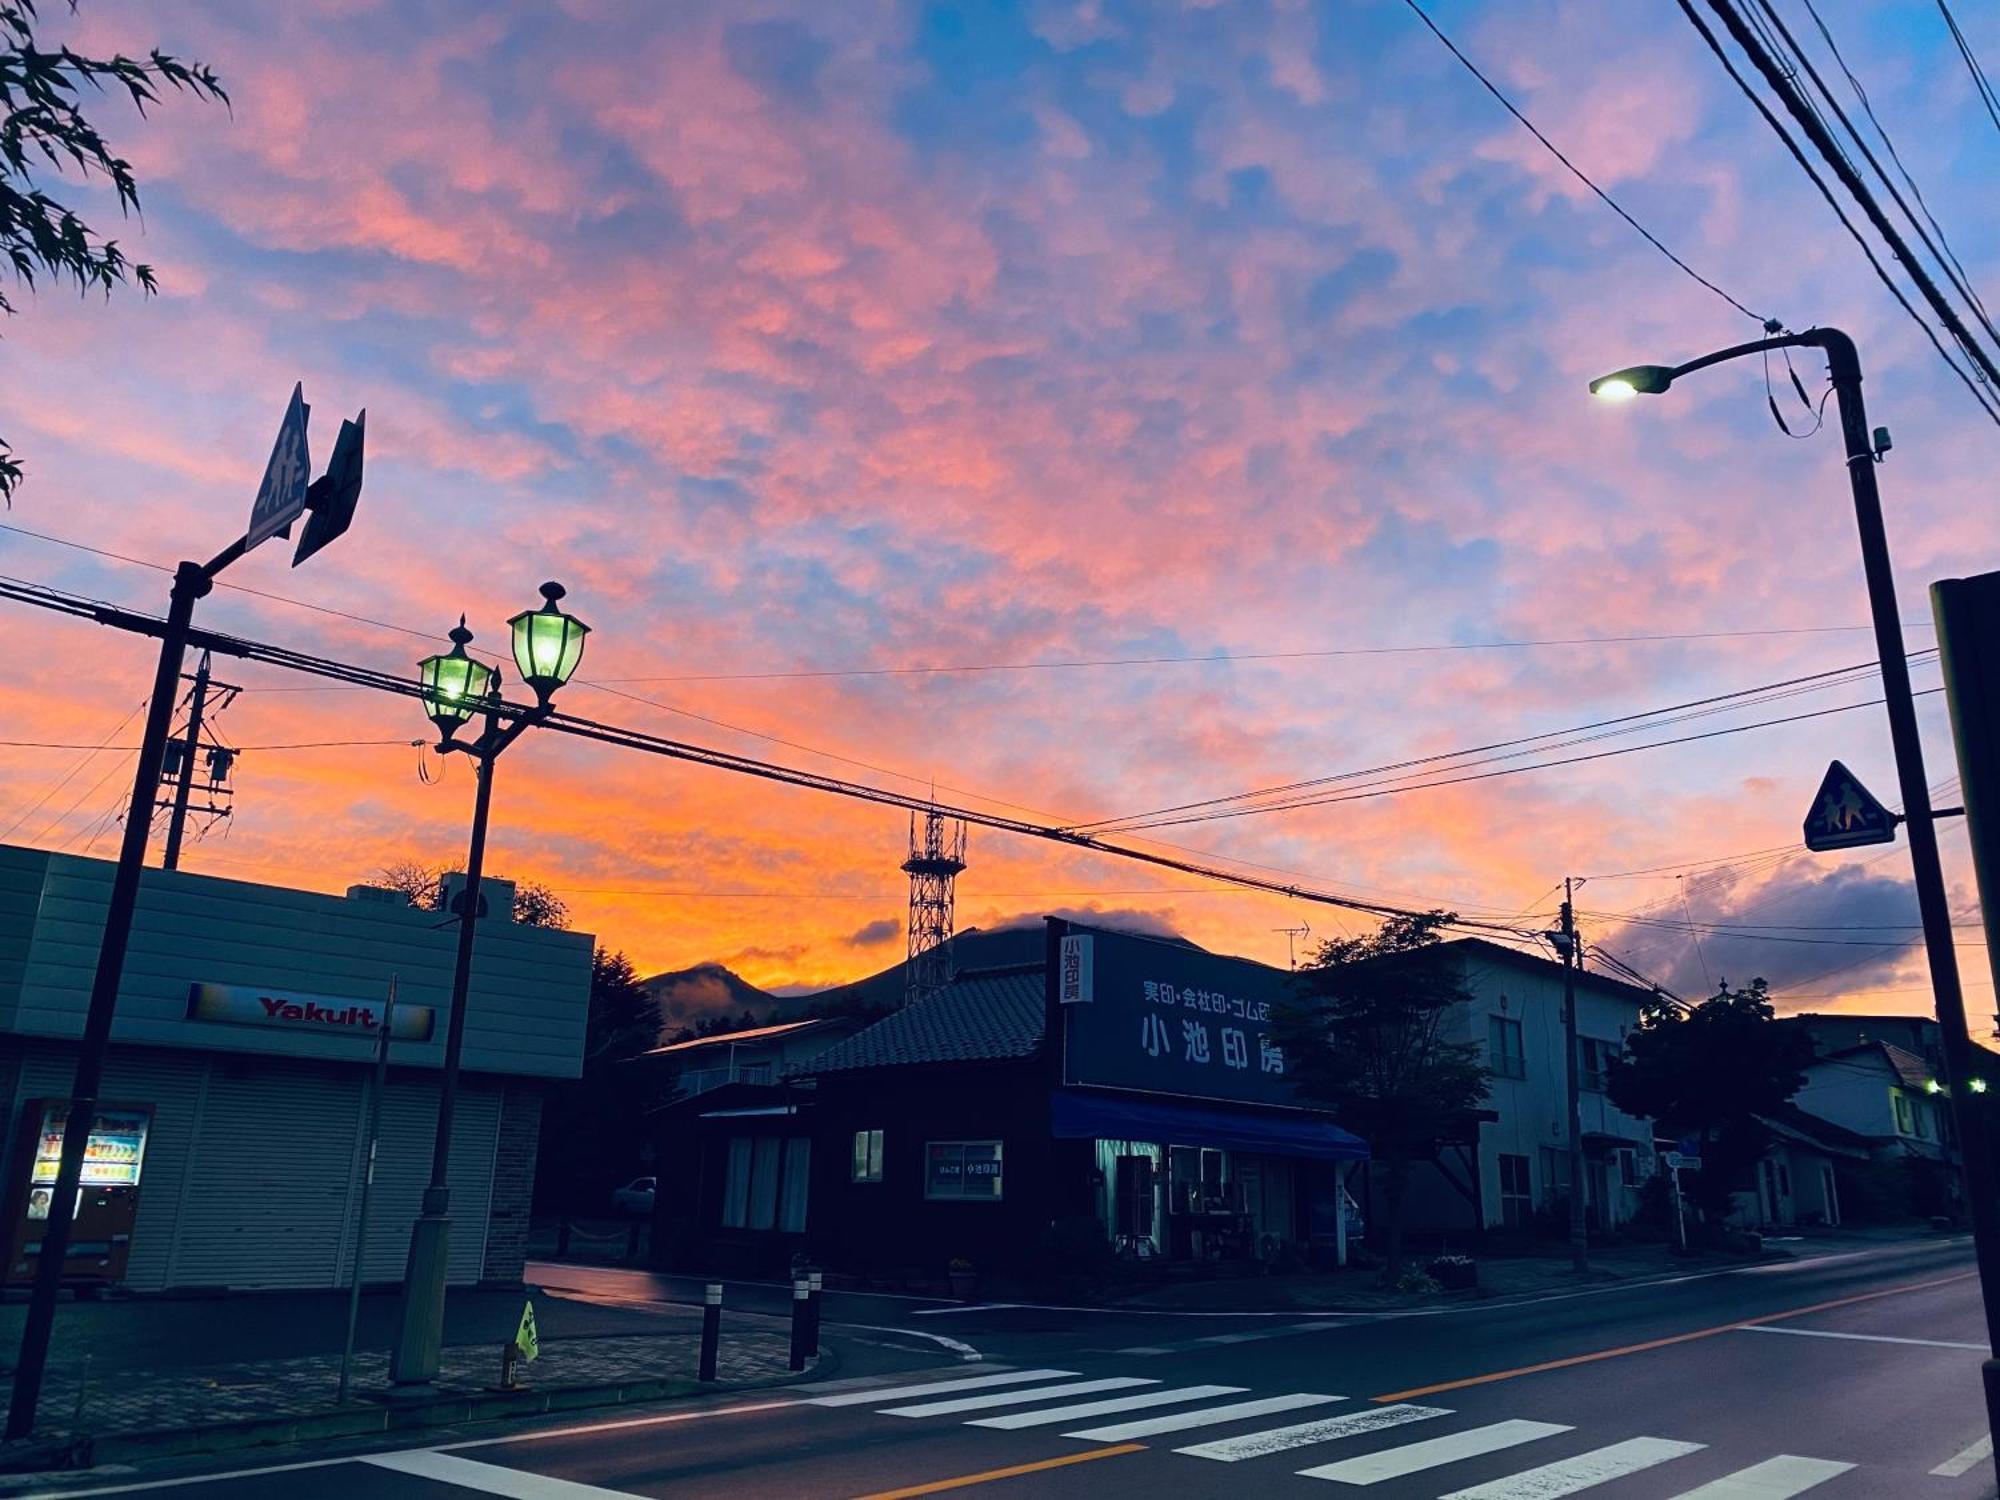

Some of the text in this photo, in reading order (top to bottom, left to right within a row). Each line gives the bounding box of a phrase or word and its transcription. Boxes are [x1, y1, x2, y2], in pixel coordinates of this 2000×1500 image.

[257, 997, 379, 1028] Yakult
[1142, 1013, 1284, 1074] 小池印房
